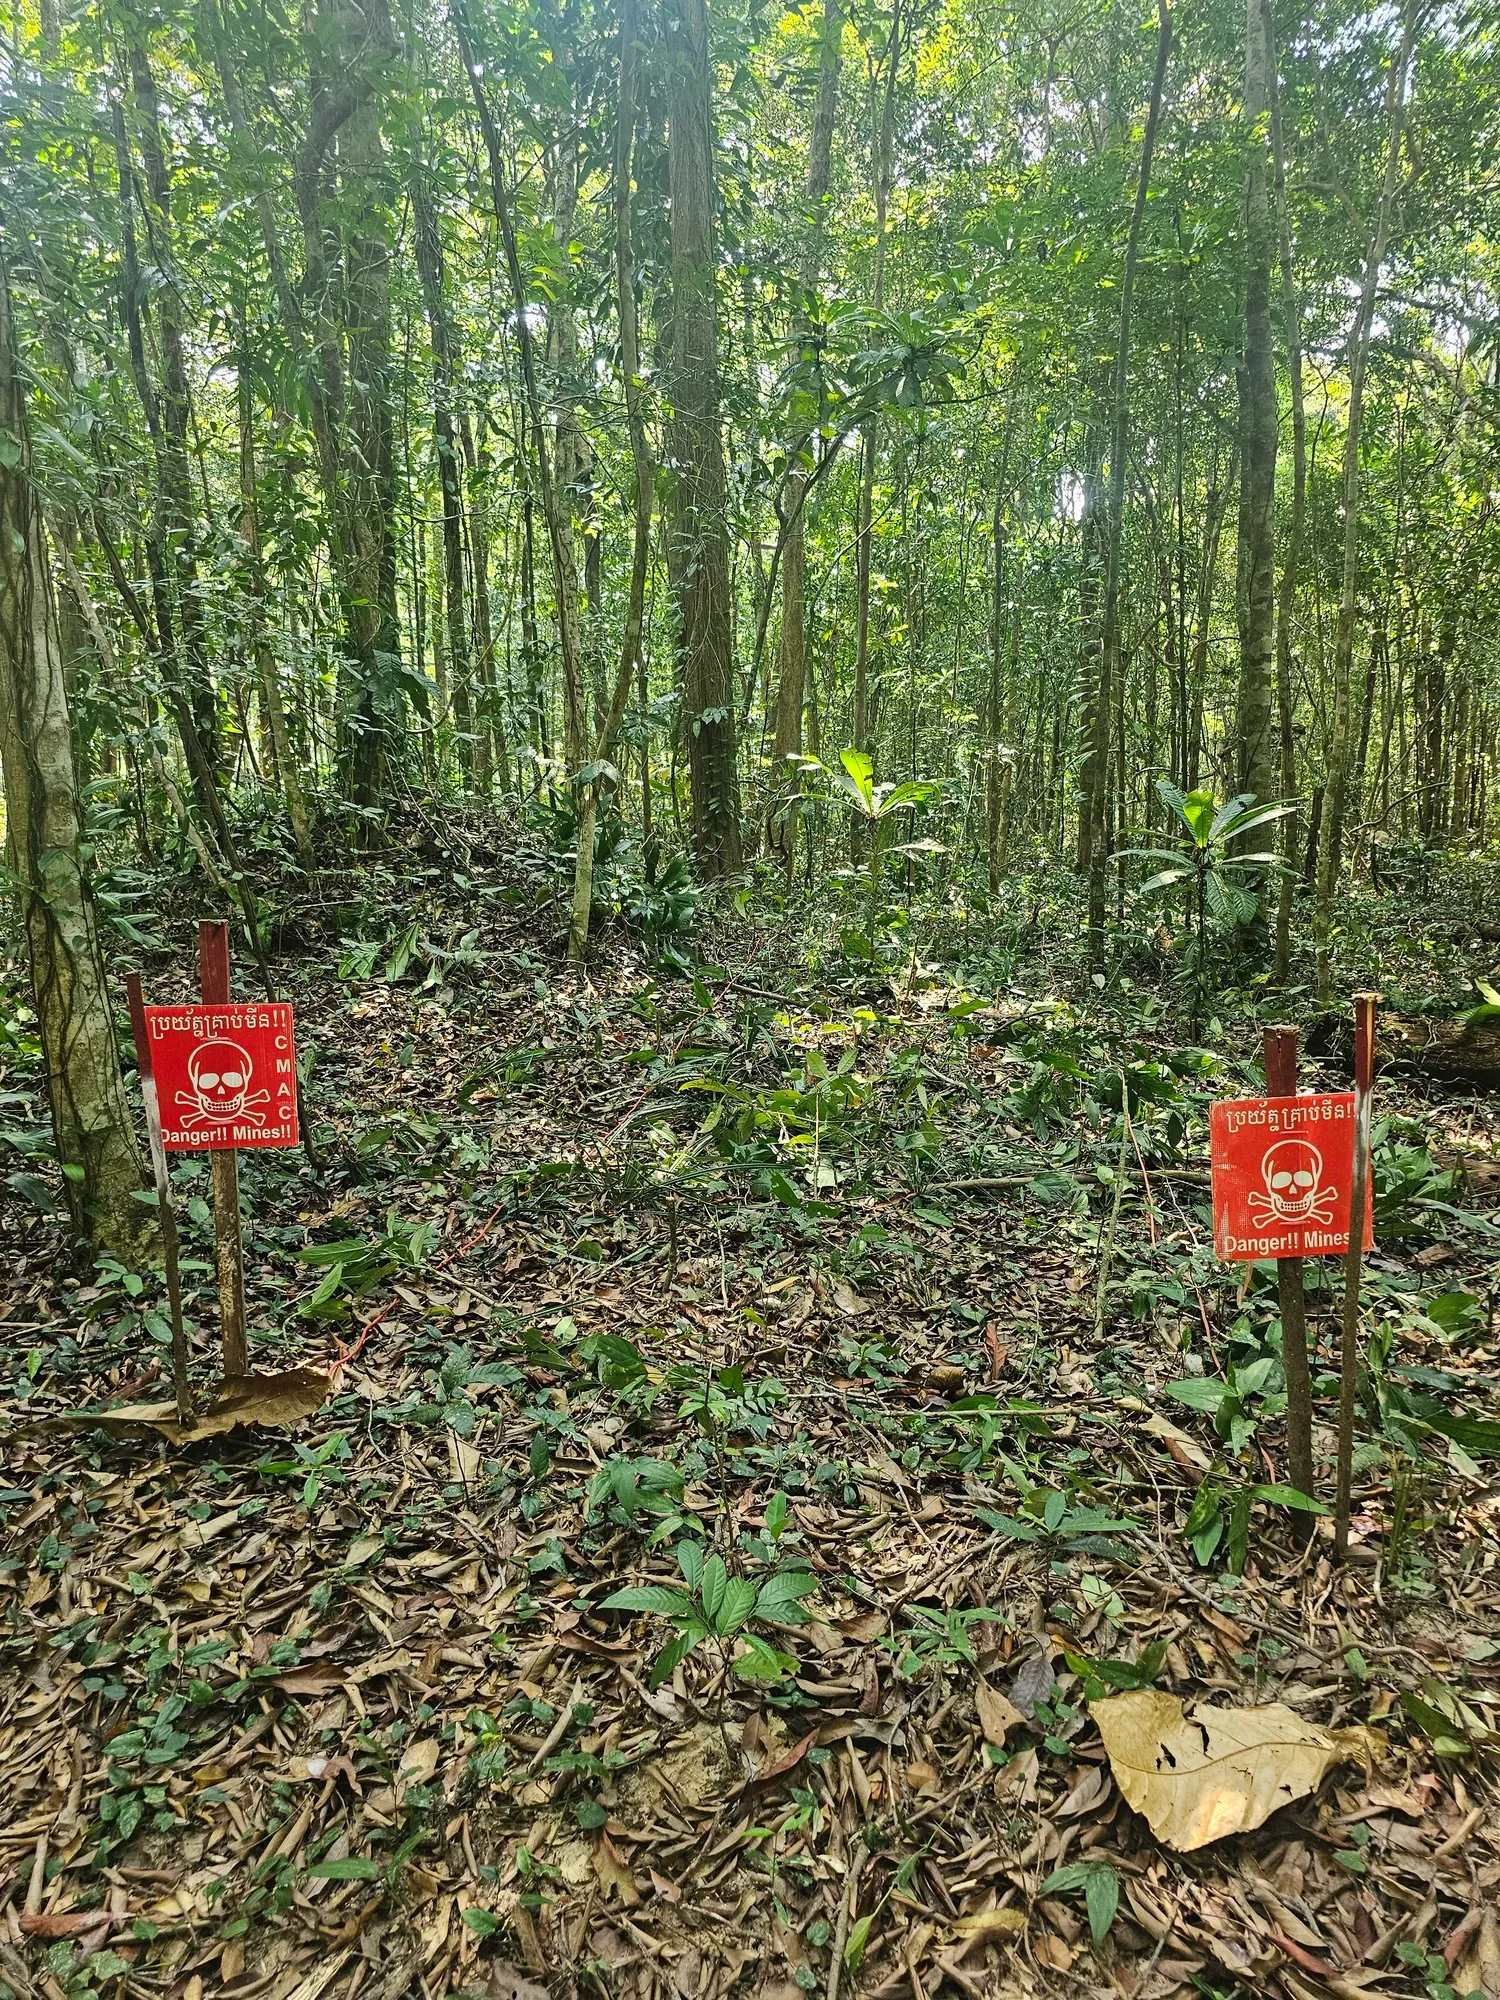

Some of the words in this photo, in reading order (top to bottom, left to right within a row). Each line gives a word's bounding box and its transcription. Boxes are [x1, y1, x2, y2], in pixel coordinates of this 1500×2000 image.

[274, 1035, 292, 1120] CMAC
[161, 1126, 228, 1146] Danger!!
[232, 1124, 292, 1140] Mines!!
[1224, 1232, 1299, 1256] Danger!!
